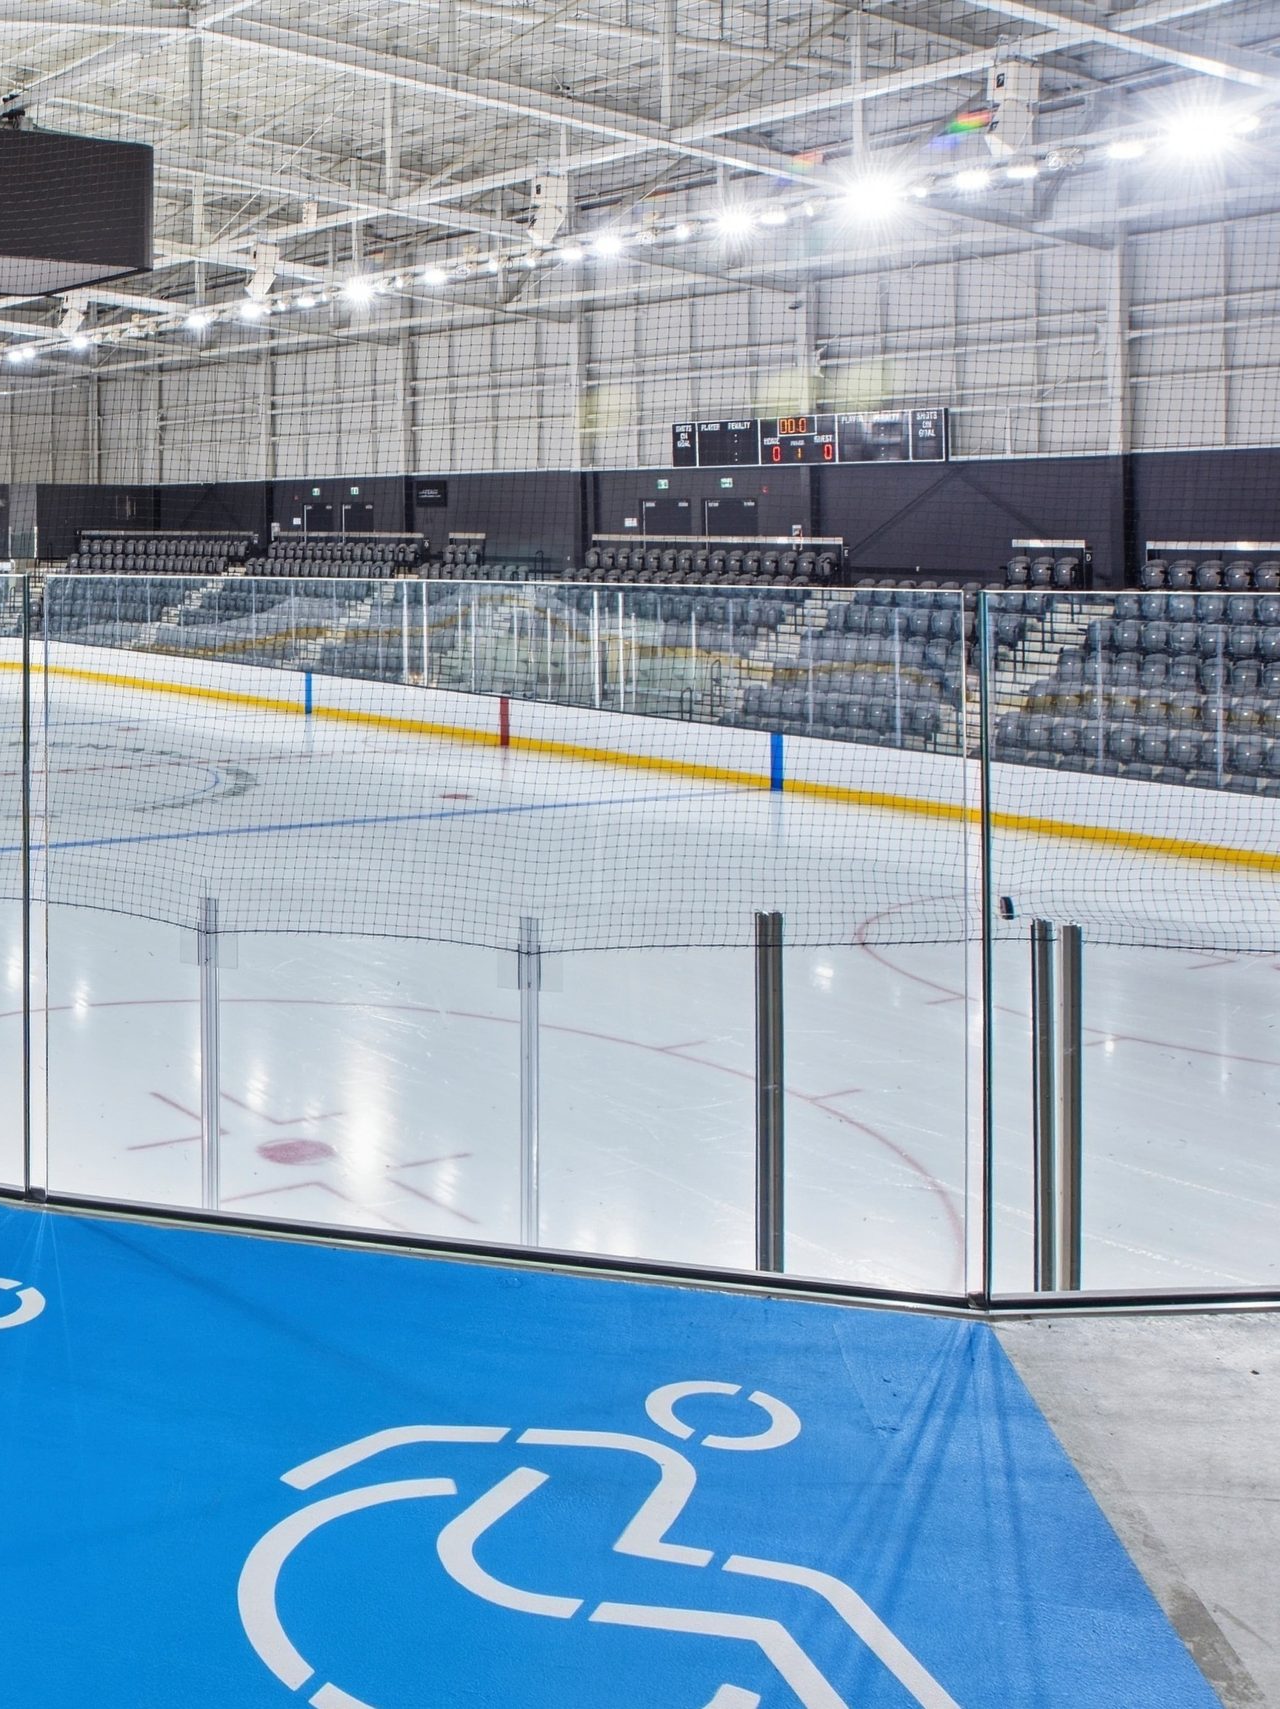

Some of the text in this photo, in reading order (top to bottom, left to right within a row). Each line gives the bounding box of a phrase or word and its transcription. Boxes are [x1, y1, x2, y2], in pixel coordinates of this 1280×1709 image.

[728, 422, 751, 430] PENALTY
[780, 418, 806, 433] 00.0
[772, 446, 781, 462] 0
[824, 444, 833, 460] 0
